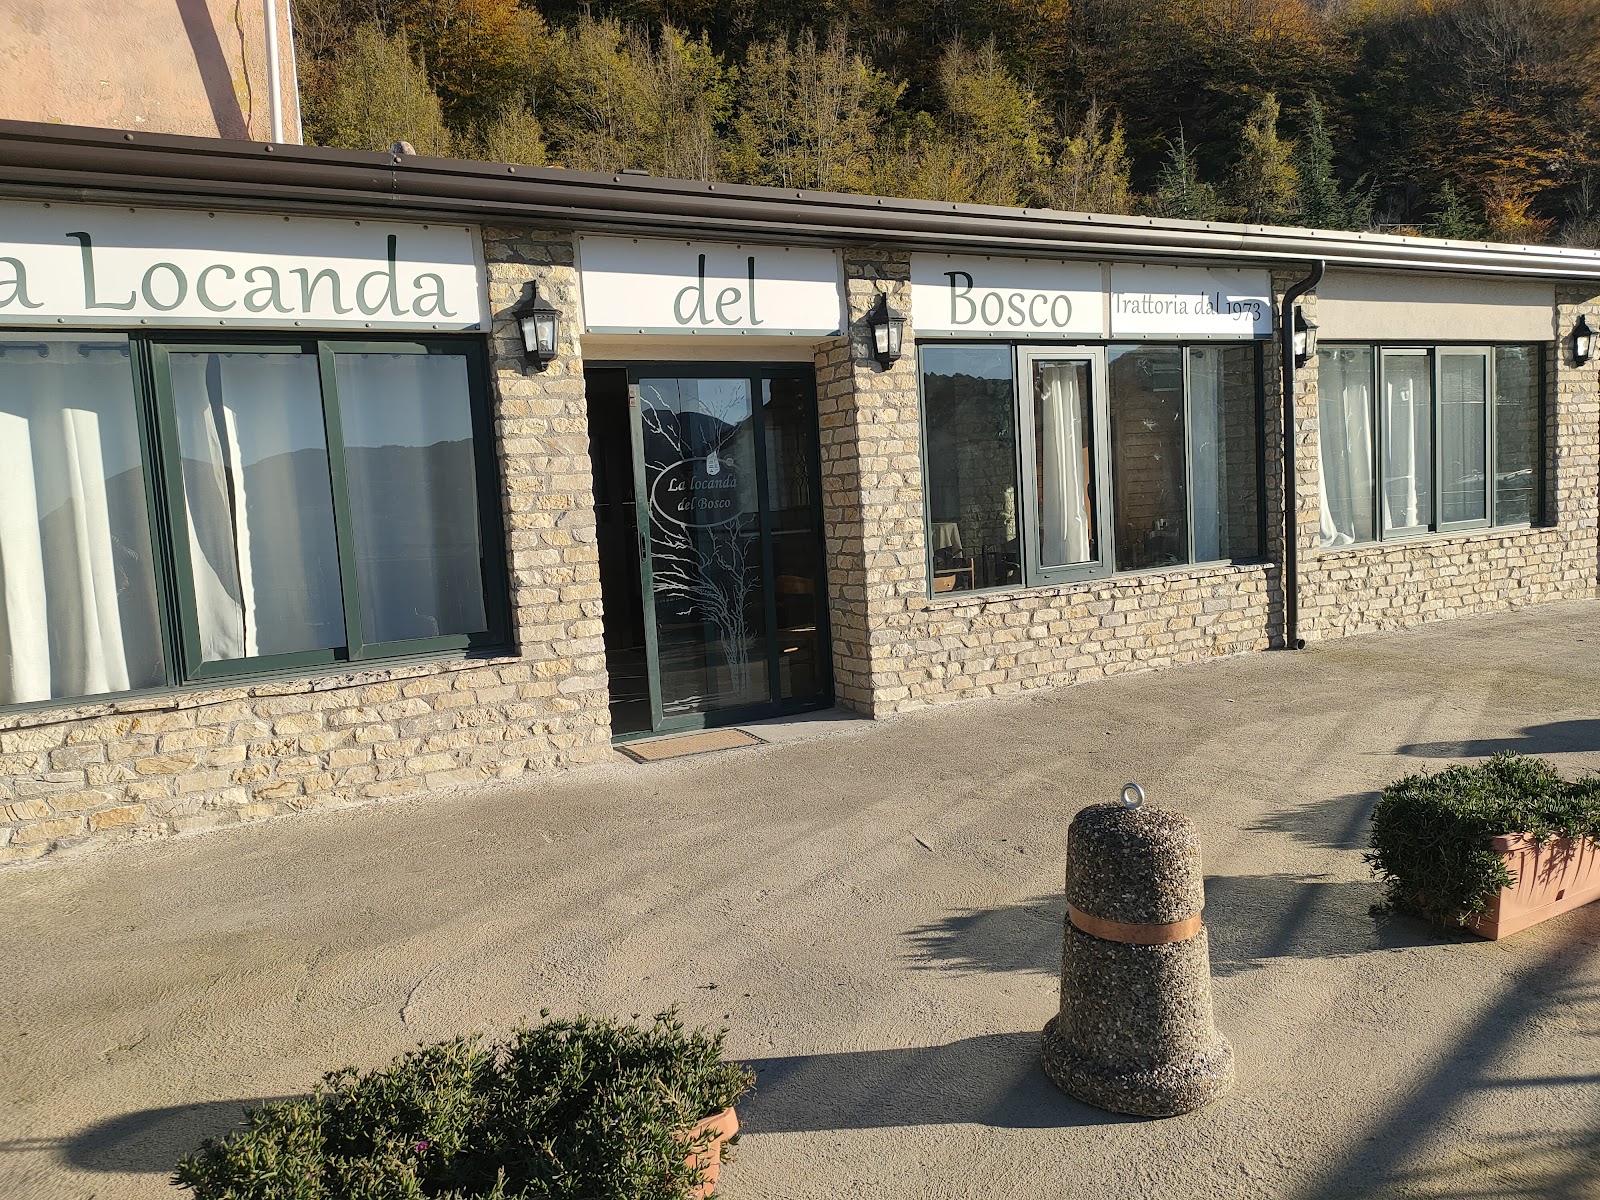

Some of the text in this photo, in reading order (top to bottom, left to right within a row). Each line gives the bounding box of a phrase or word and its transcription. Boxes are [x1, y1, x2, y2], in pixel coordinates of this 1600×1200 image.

[65, 231, 458, 318] Locanda
[673, 253, 765, 327] del
[943, 270, 1073, 328] Bosco
[1111, 291, 1261, 321] Trattoria dal 1973
[667, 477, 686, 492] La
[677, 497, 731, 511] del Bosco
